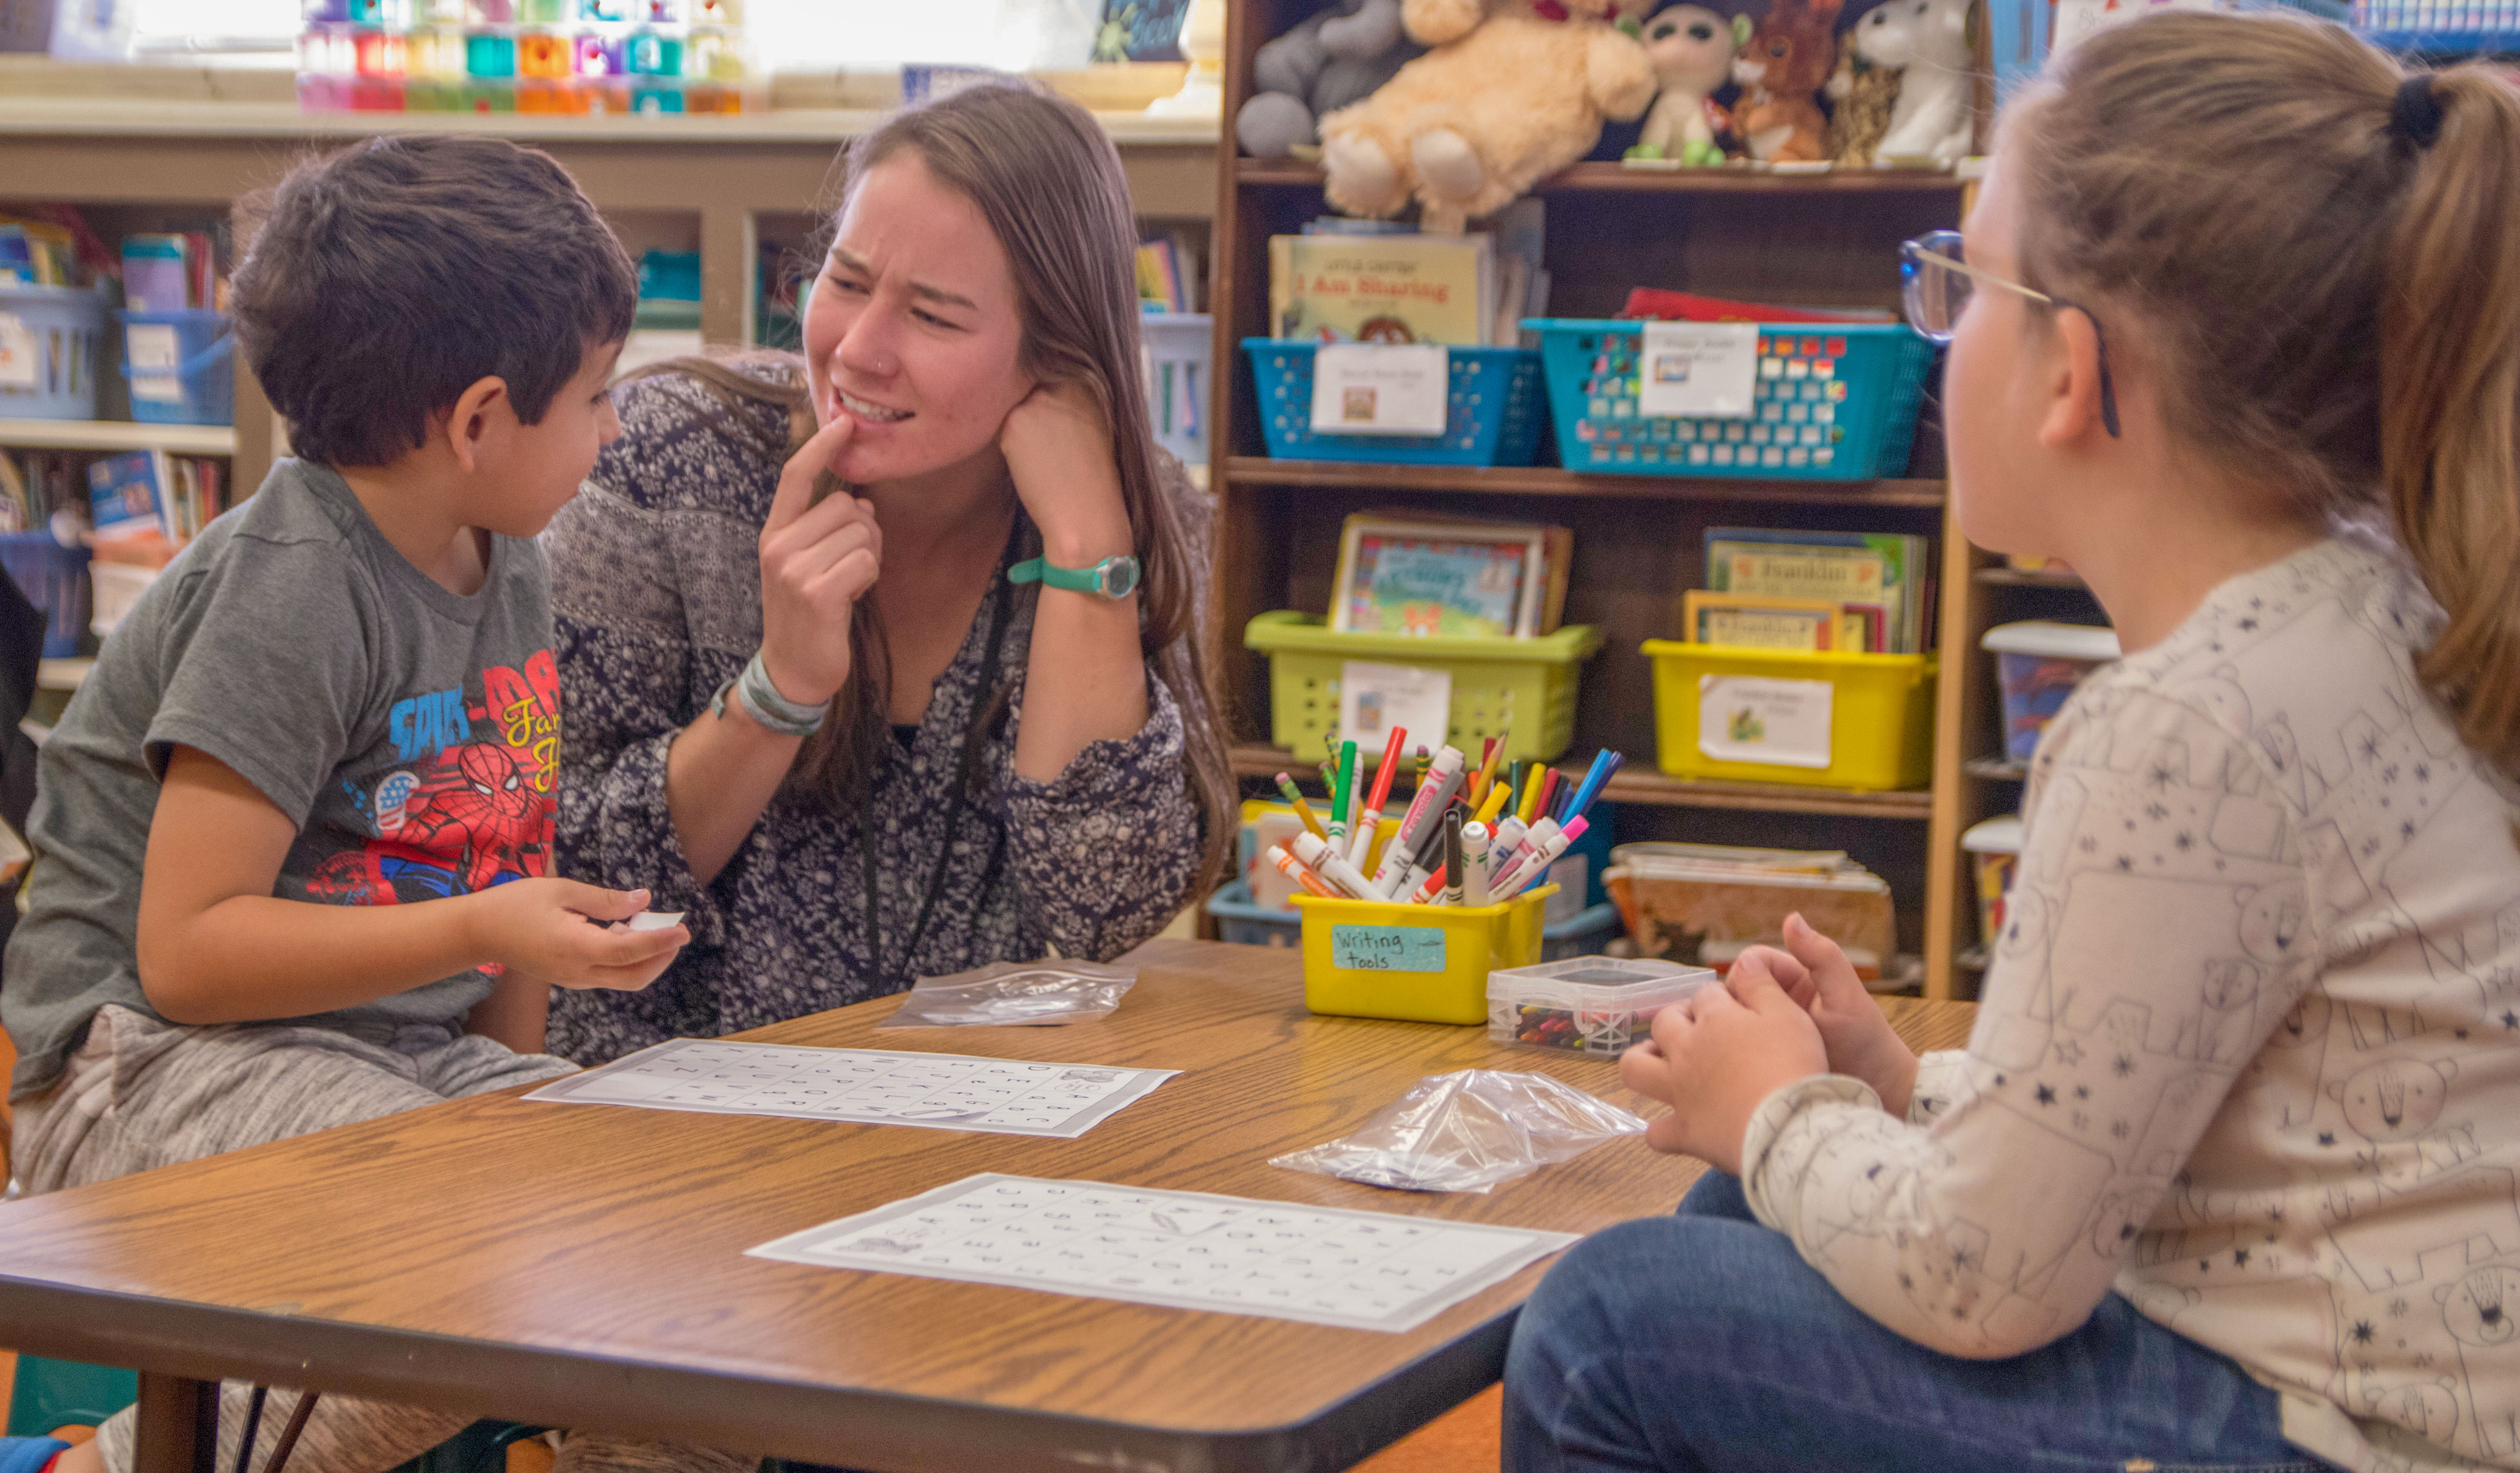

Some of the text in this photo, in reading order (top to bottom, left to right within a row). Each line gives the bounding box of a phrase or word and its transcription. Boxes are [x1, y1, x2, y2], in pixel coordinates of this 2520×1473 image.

[1297, 273, 1305, 293] I
[1312, 275, 1351, 294] Am
[1357, 277, 1451, 304] Sharing
[1763, 558, 1847, 581] Franklin
[1336, 932, 1403, 955] Writing
[1347, 951, 1389, 968] tools
